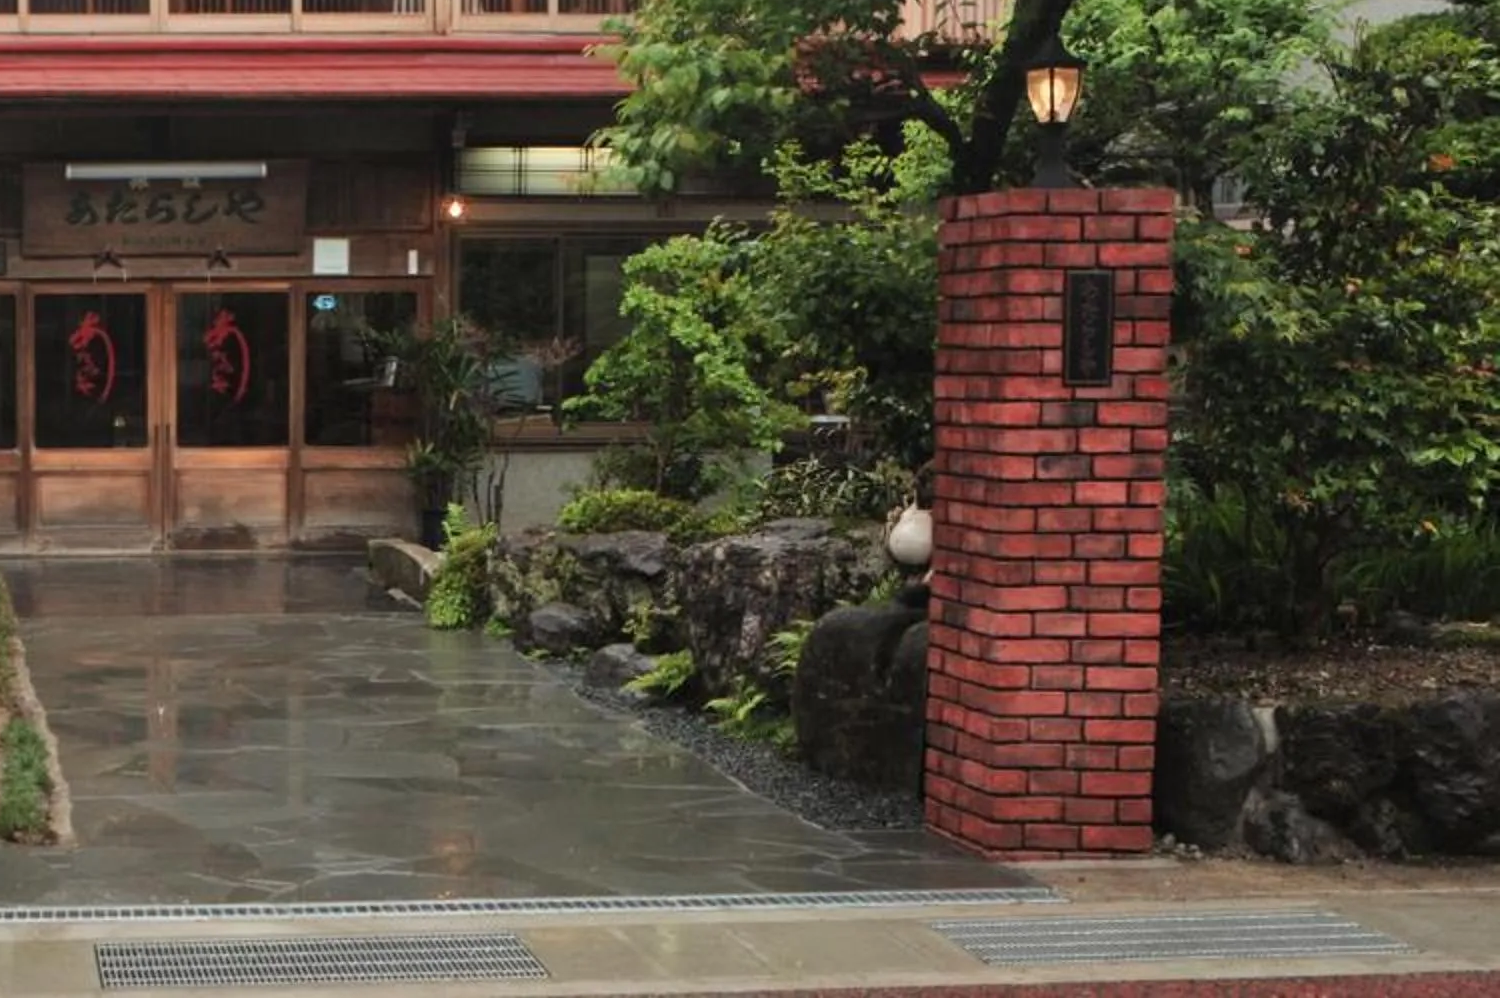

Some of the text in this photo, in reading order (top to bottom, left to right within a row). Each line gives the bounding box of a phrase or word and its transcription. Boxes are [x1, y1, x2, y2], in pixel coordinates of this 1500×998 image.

[67, 188, 265, 225] あたらしや
